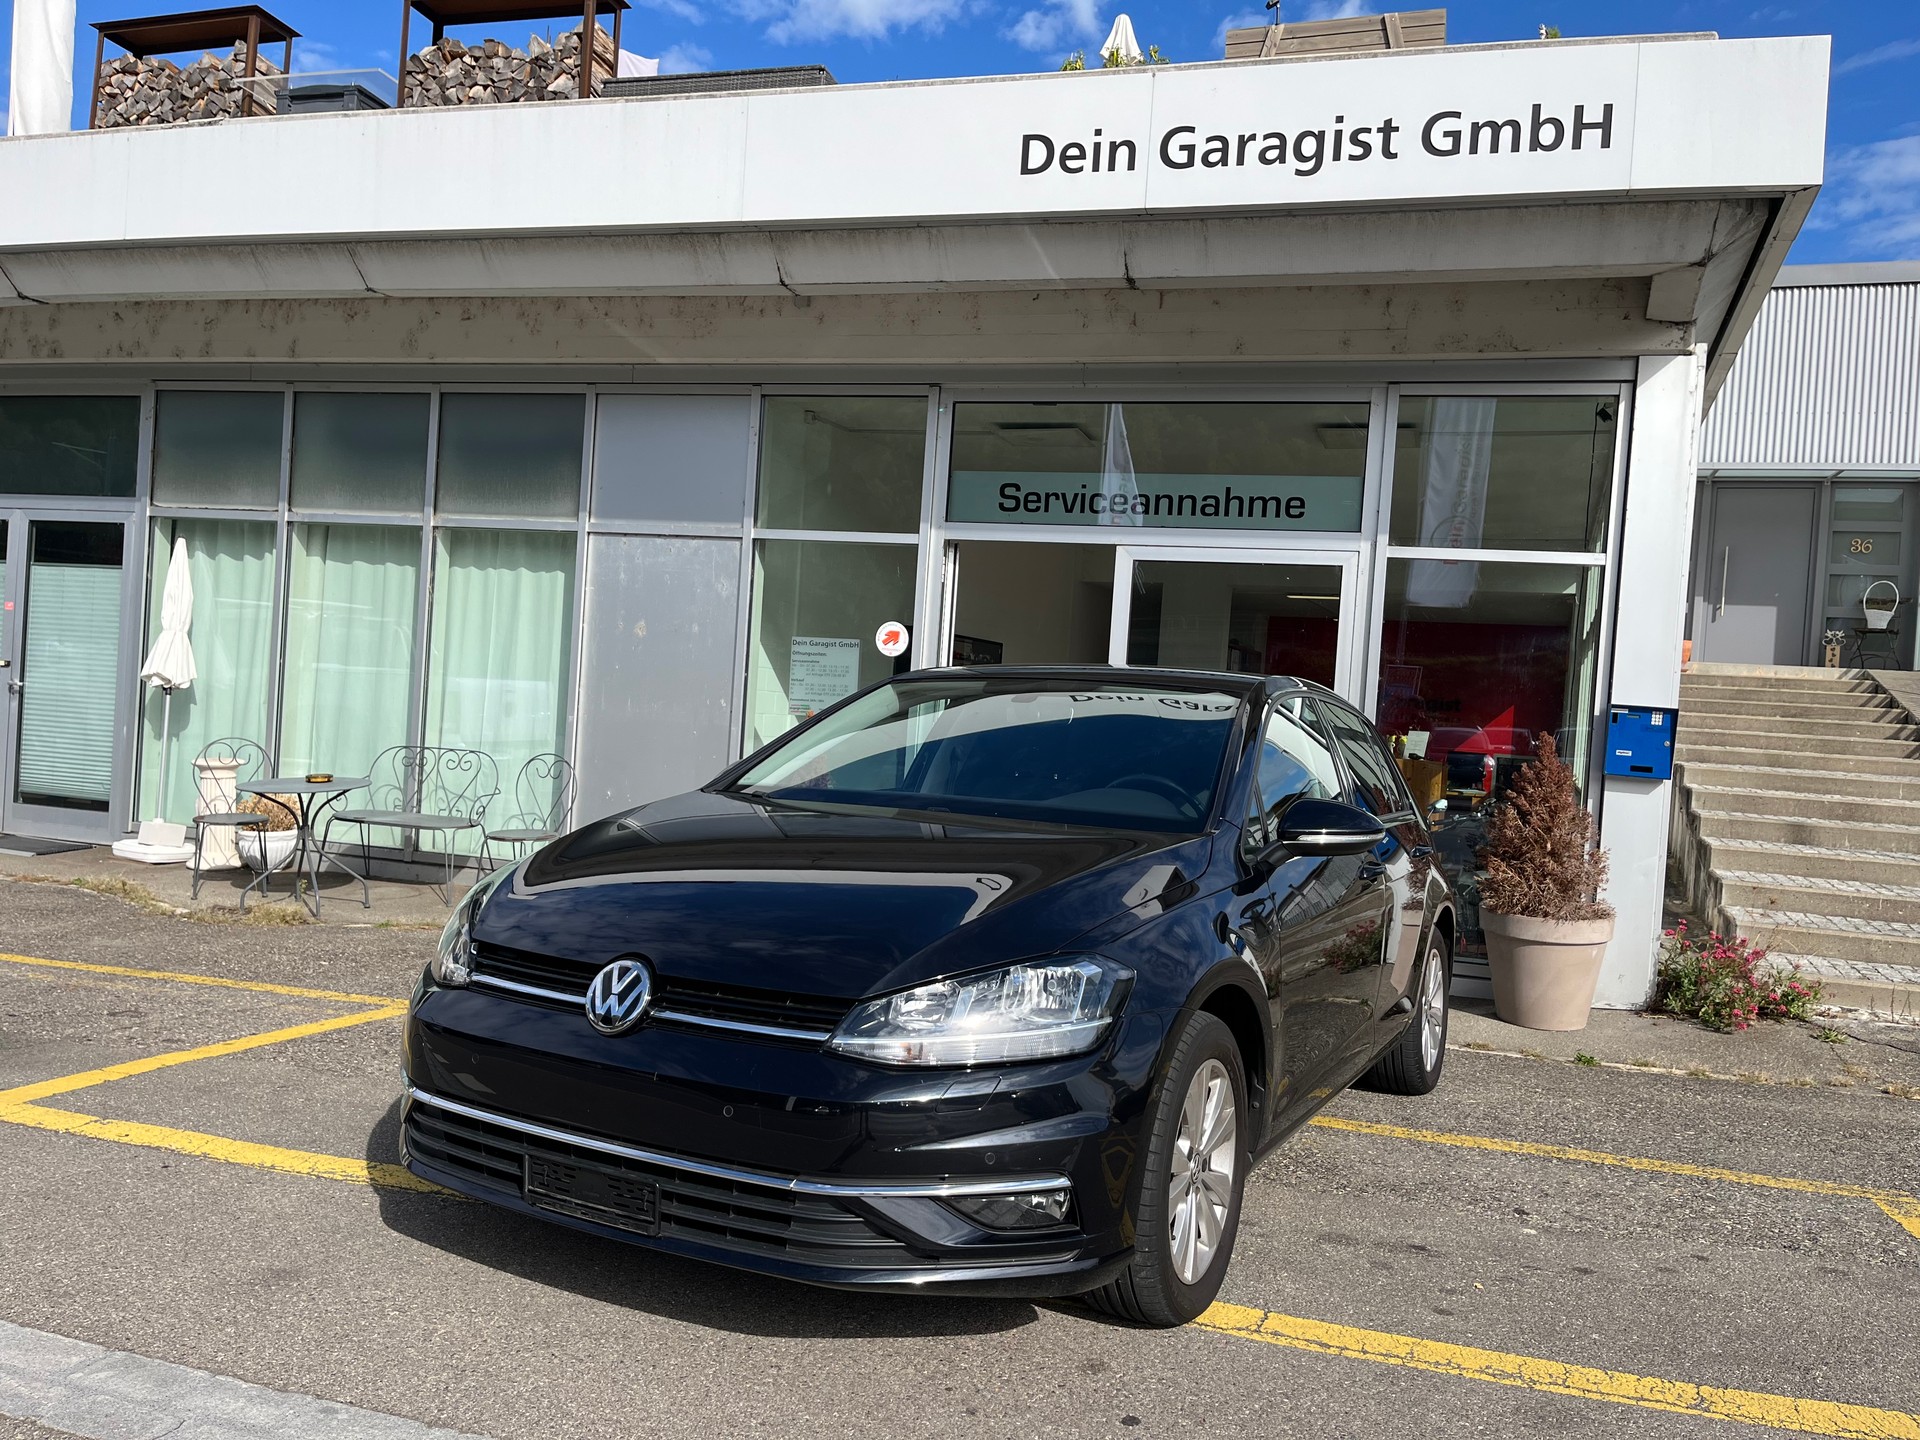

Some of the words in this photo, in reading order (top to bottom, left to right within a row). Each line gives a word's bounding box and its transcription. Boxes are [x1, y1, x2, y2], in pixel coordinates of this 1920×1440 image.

[1020, 128, 1137, 176] Dein
[1158, 114, 1400, 176] Garagist
[1420, 103, 1614, 158] GmbH
[998, 482, 1306, 519] Serviceannahme
[1850, 538, 1873, 554] 36
[809, 639, 837, 649] Garagist
[838, 640, 859, 649] GmbH
